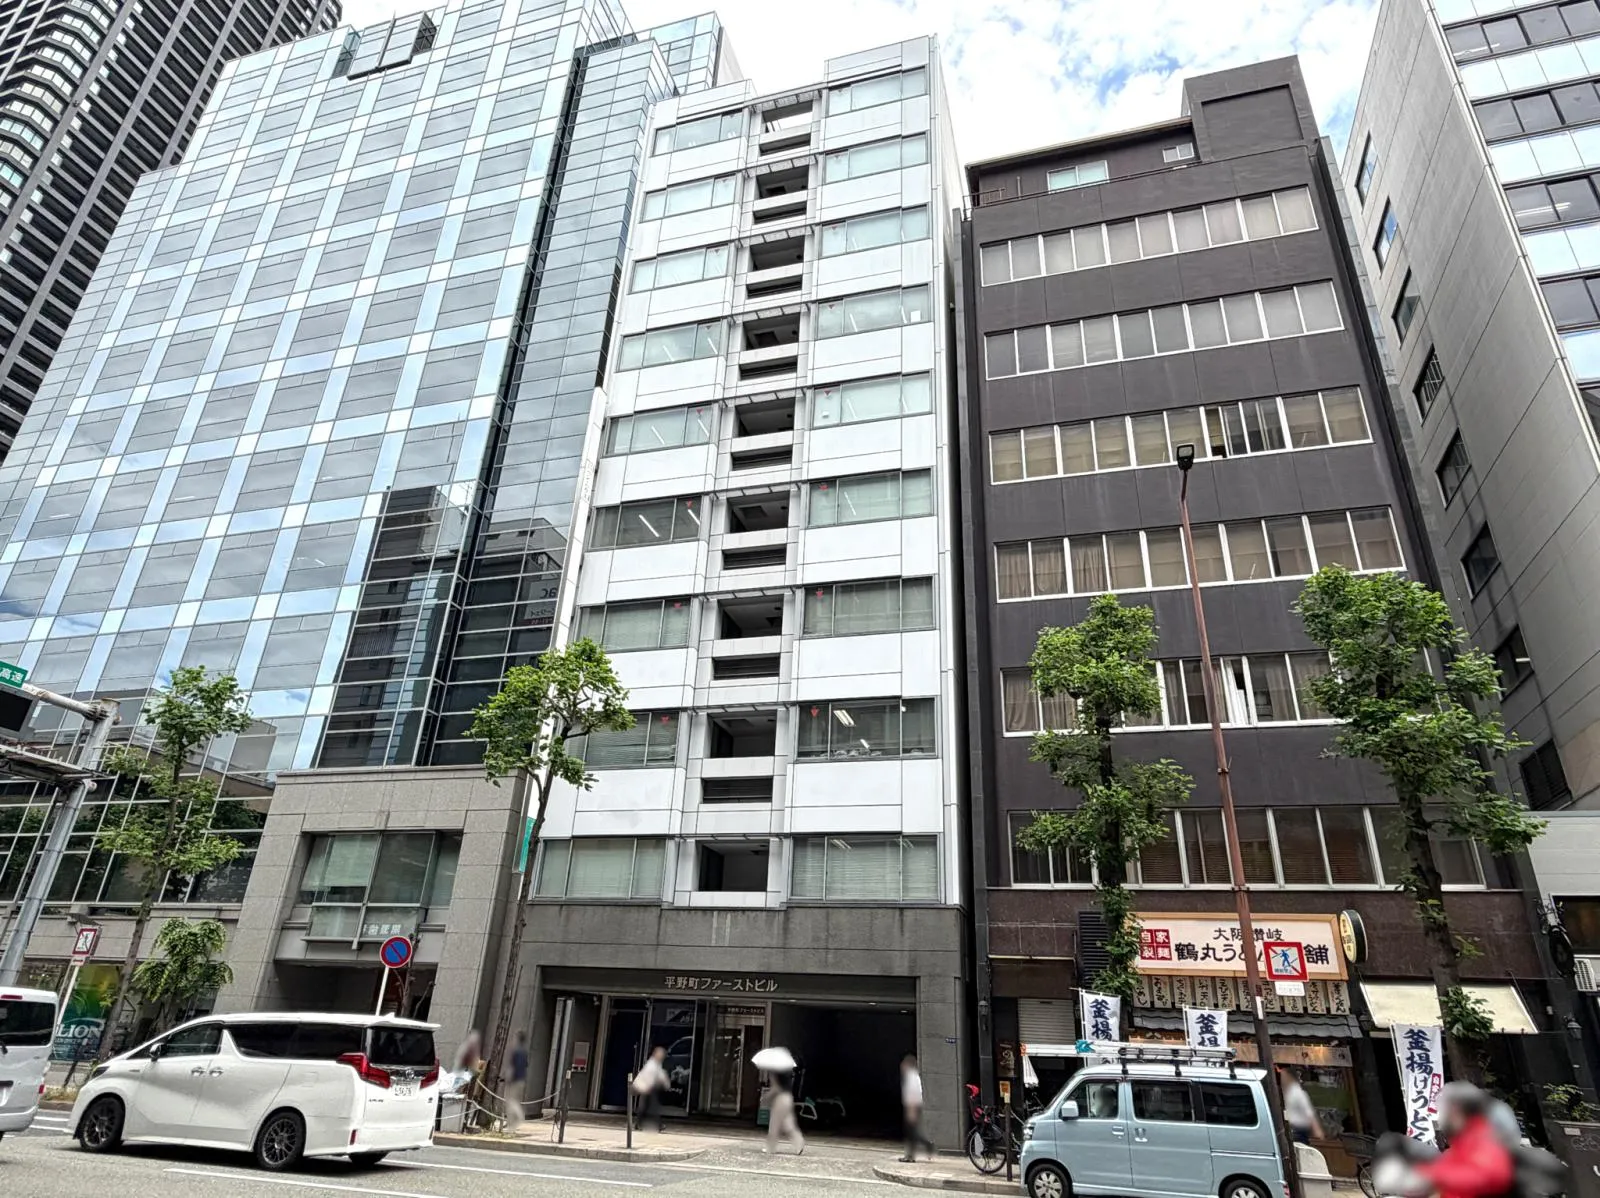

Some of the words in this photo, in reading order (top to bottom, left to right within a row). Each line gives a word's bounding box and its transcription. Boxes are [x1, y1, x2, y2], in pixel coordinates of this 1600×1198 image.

[664, 976, 779, 992] 平野町ファーストビル
